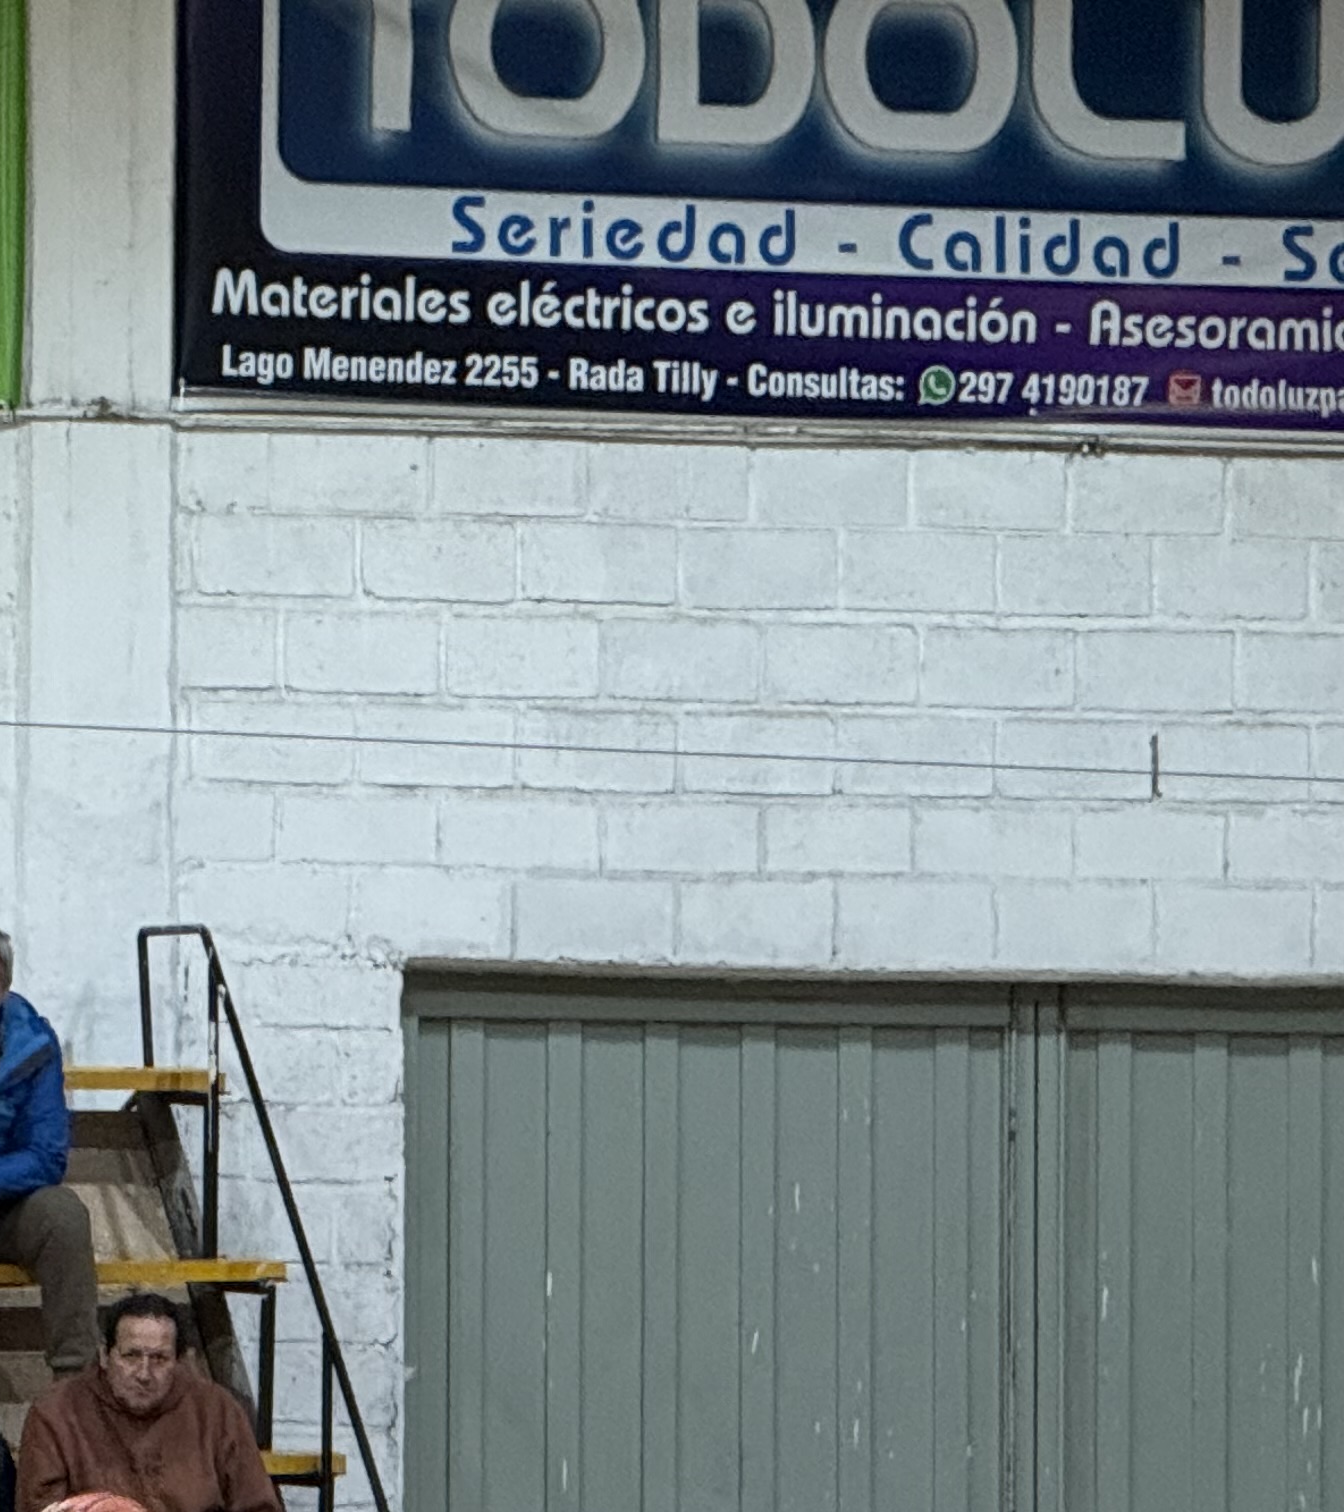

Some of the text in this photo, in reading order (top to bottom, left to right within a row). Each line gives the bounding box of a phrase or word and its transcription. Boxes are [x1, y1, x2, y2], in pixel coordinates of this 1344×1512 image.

[451, 194, 797, 265] Seriedad
[898, 212, 1181, 279] Calidad
[212, 267, 471, 324] Materiales
[487, 280, 709, 334] eléctricos
[725, 300, 756, 335] e
[773, 289, 1038, 344] iluminación
[222, 344, 293, 385] Lago
[304, 347, 457, 384] Menendez
[465, 354, 539, 388] 2255
[569, 357, 644, 393] Rada
[653, 360, 718, 401] Tilly
[747, 363, 905, 401] Consultas:
[959, 370, 1150, 408] 297 4190187
